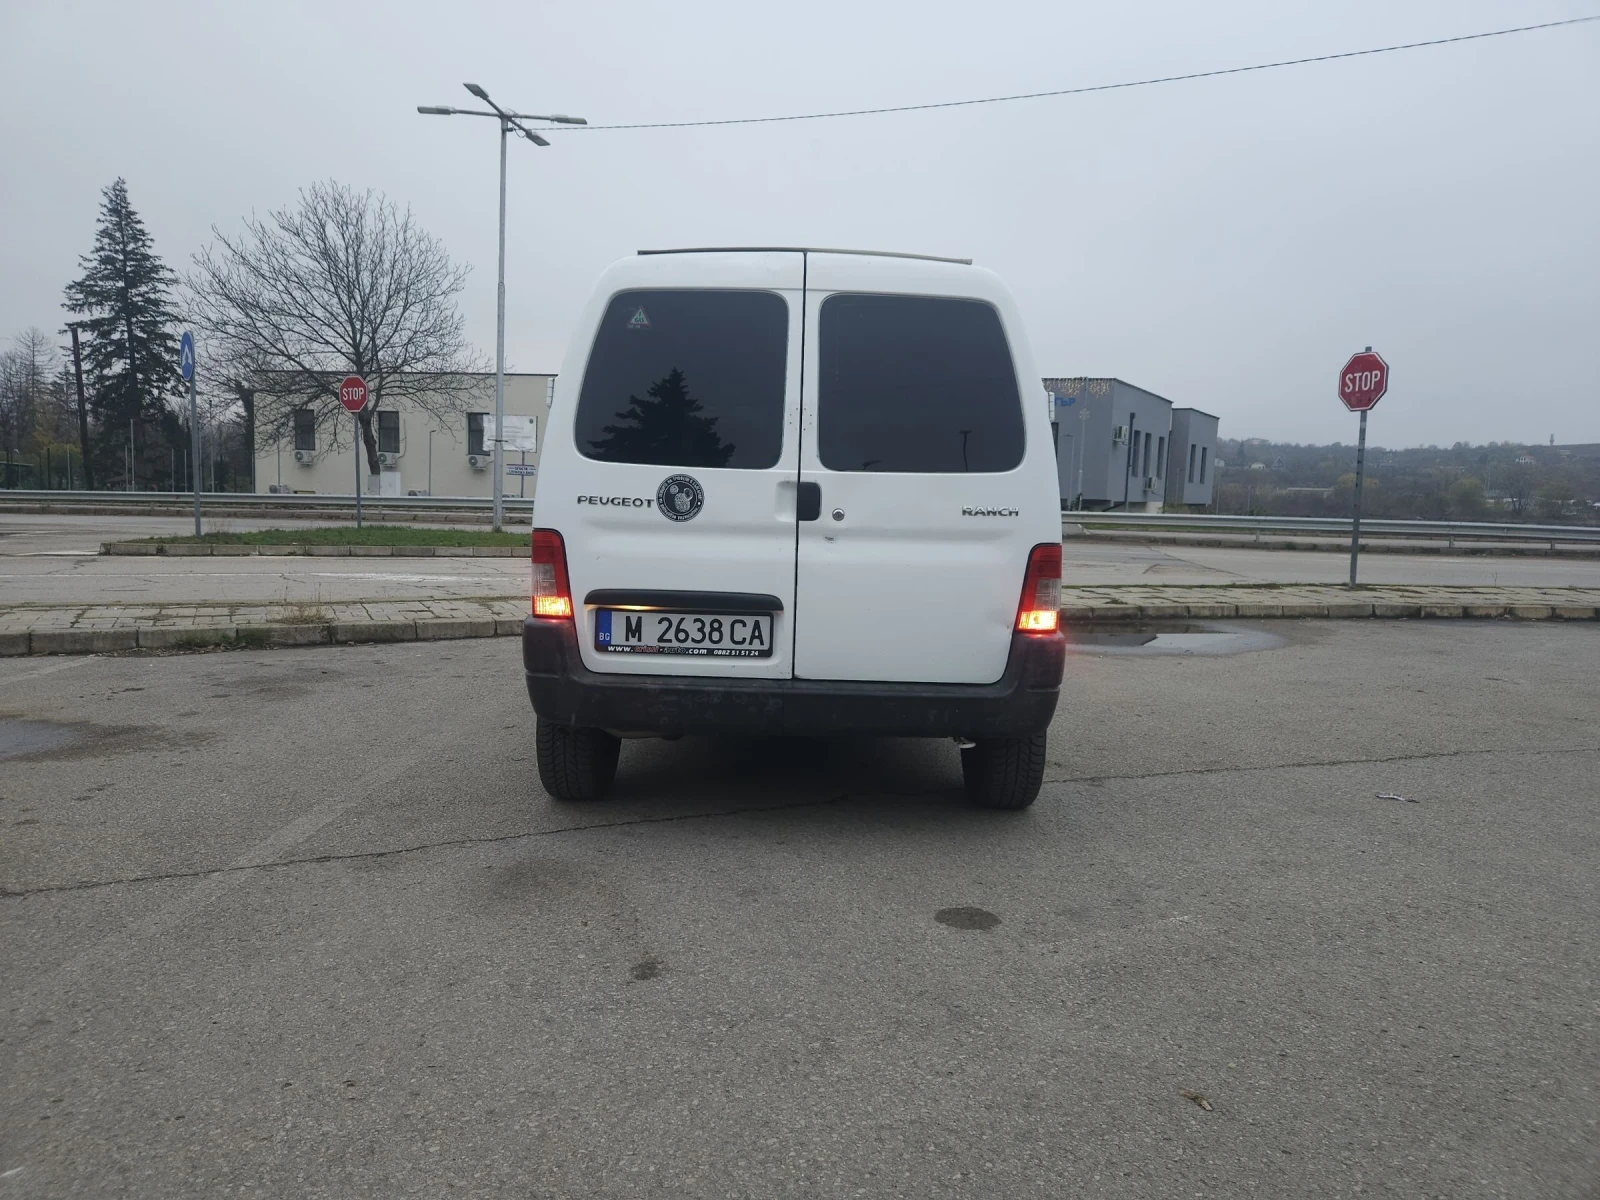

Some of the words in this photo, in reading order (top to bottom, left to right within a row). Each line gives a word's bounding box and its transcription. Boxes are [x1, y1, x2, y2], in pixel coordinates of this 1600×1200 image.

[1344, 370, 1381, 393] STOP
[342, 387, 365, 401] STOP
[577, 495, 654, 508] PEUGEOT
[961, 505, 1019, 517] RANCH
[599, 632, 611, 641] BG
[625, 615, 643, 643] M
[657, 616, 724, 645] 2638
